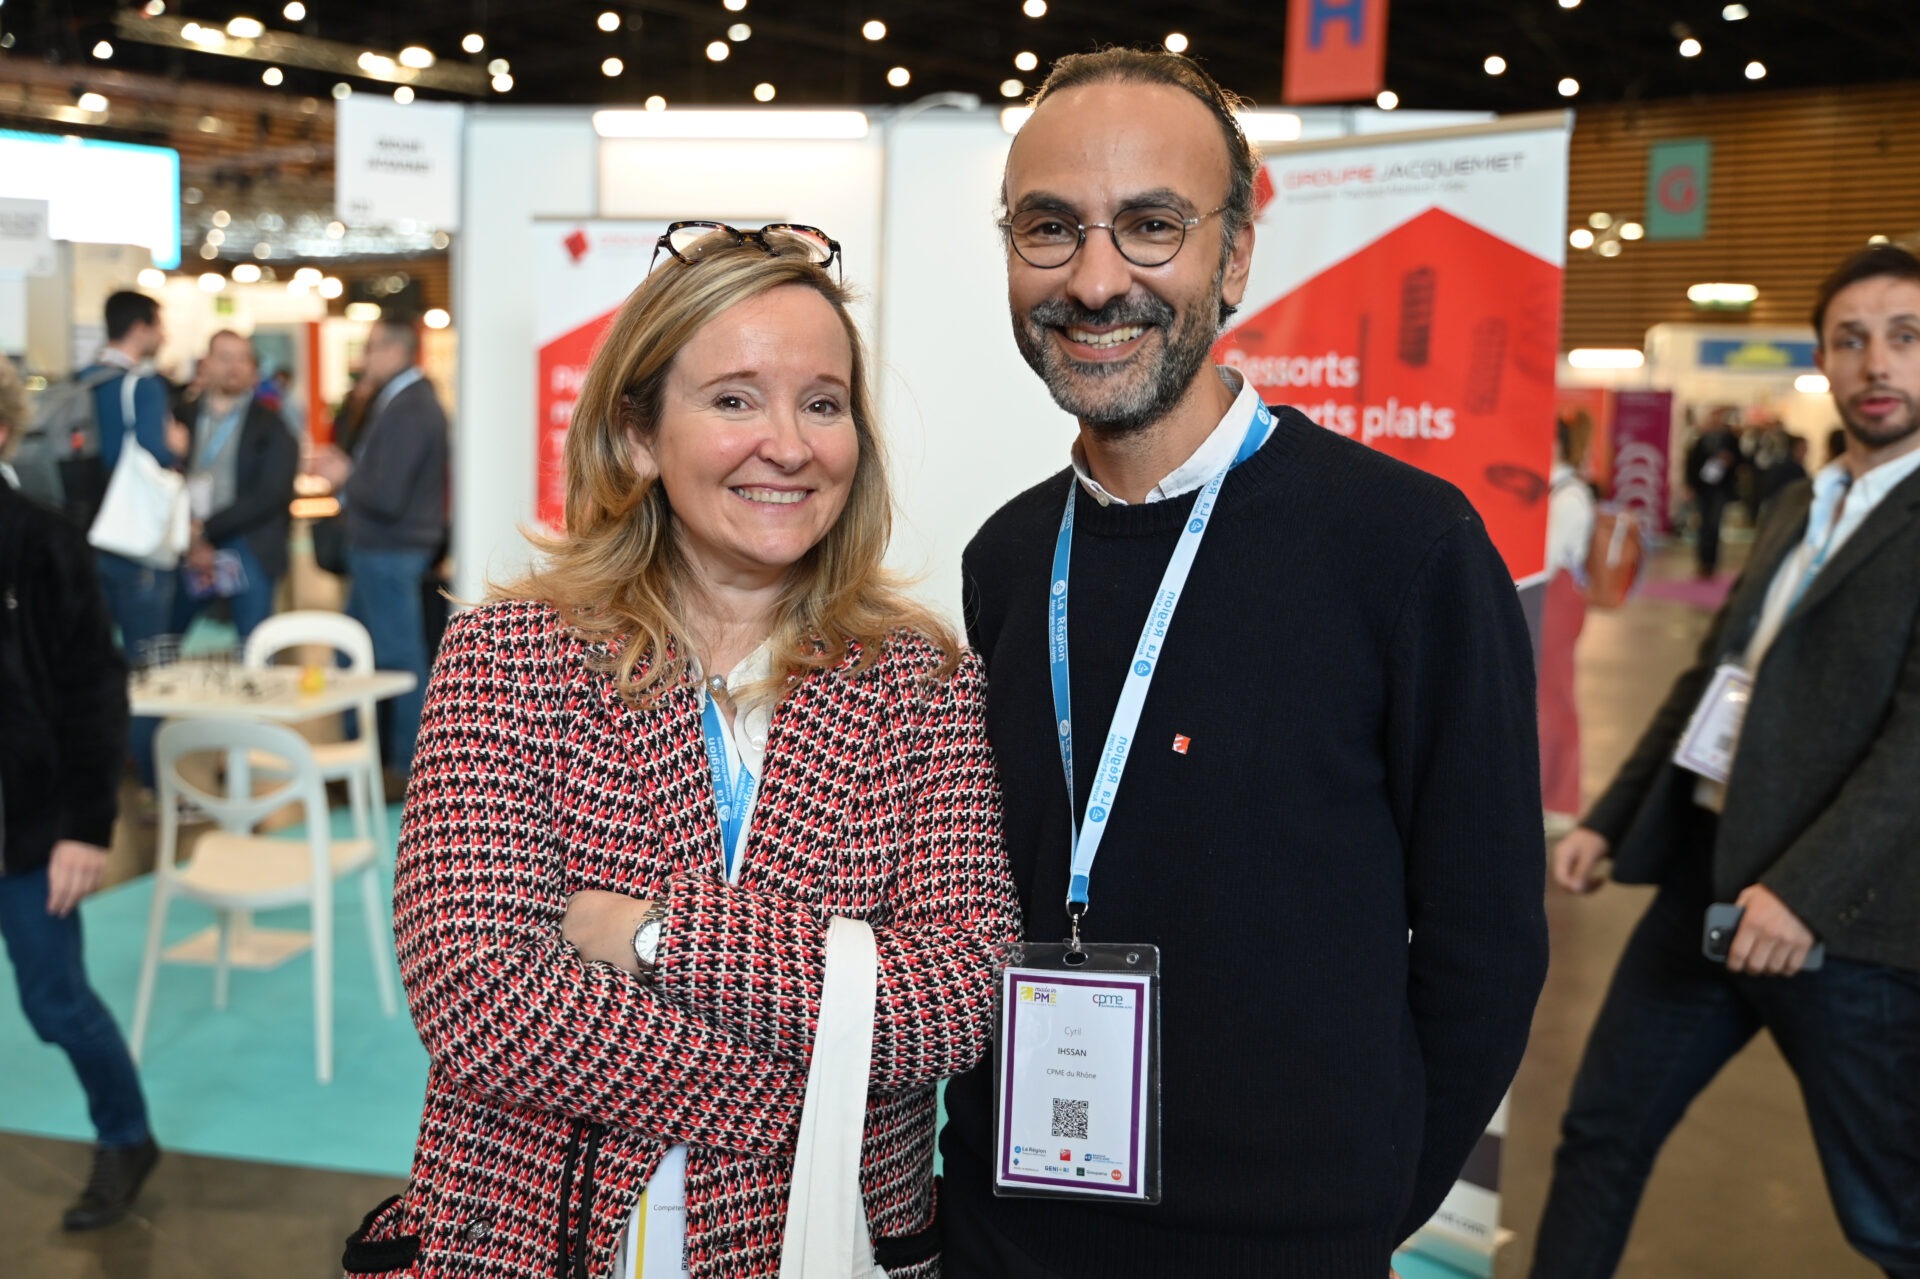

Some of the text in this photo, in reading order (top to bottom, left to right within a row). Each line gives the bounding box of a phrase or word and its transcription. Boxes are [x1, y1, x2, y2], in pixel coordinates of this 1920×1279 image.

[1657, 165, 1698, 215] G
[1361, 397, 1455, 445] plats
[1055, 595, 1066, 662] La Région
[707, 737, 725, 804] La Région
[1034, 992, 1057, 1004] PME
[1092, 994, 1123, 1007] cpme
[1064, 1026, 1082, 1037] Cyril
[1057, 1047, 1087, 1057] IHSSAN
[1046, 1068, 1065, 1076] CPME
[1076, 1071, 1097, 1079] Rhône
